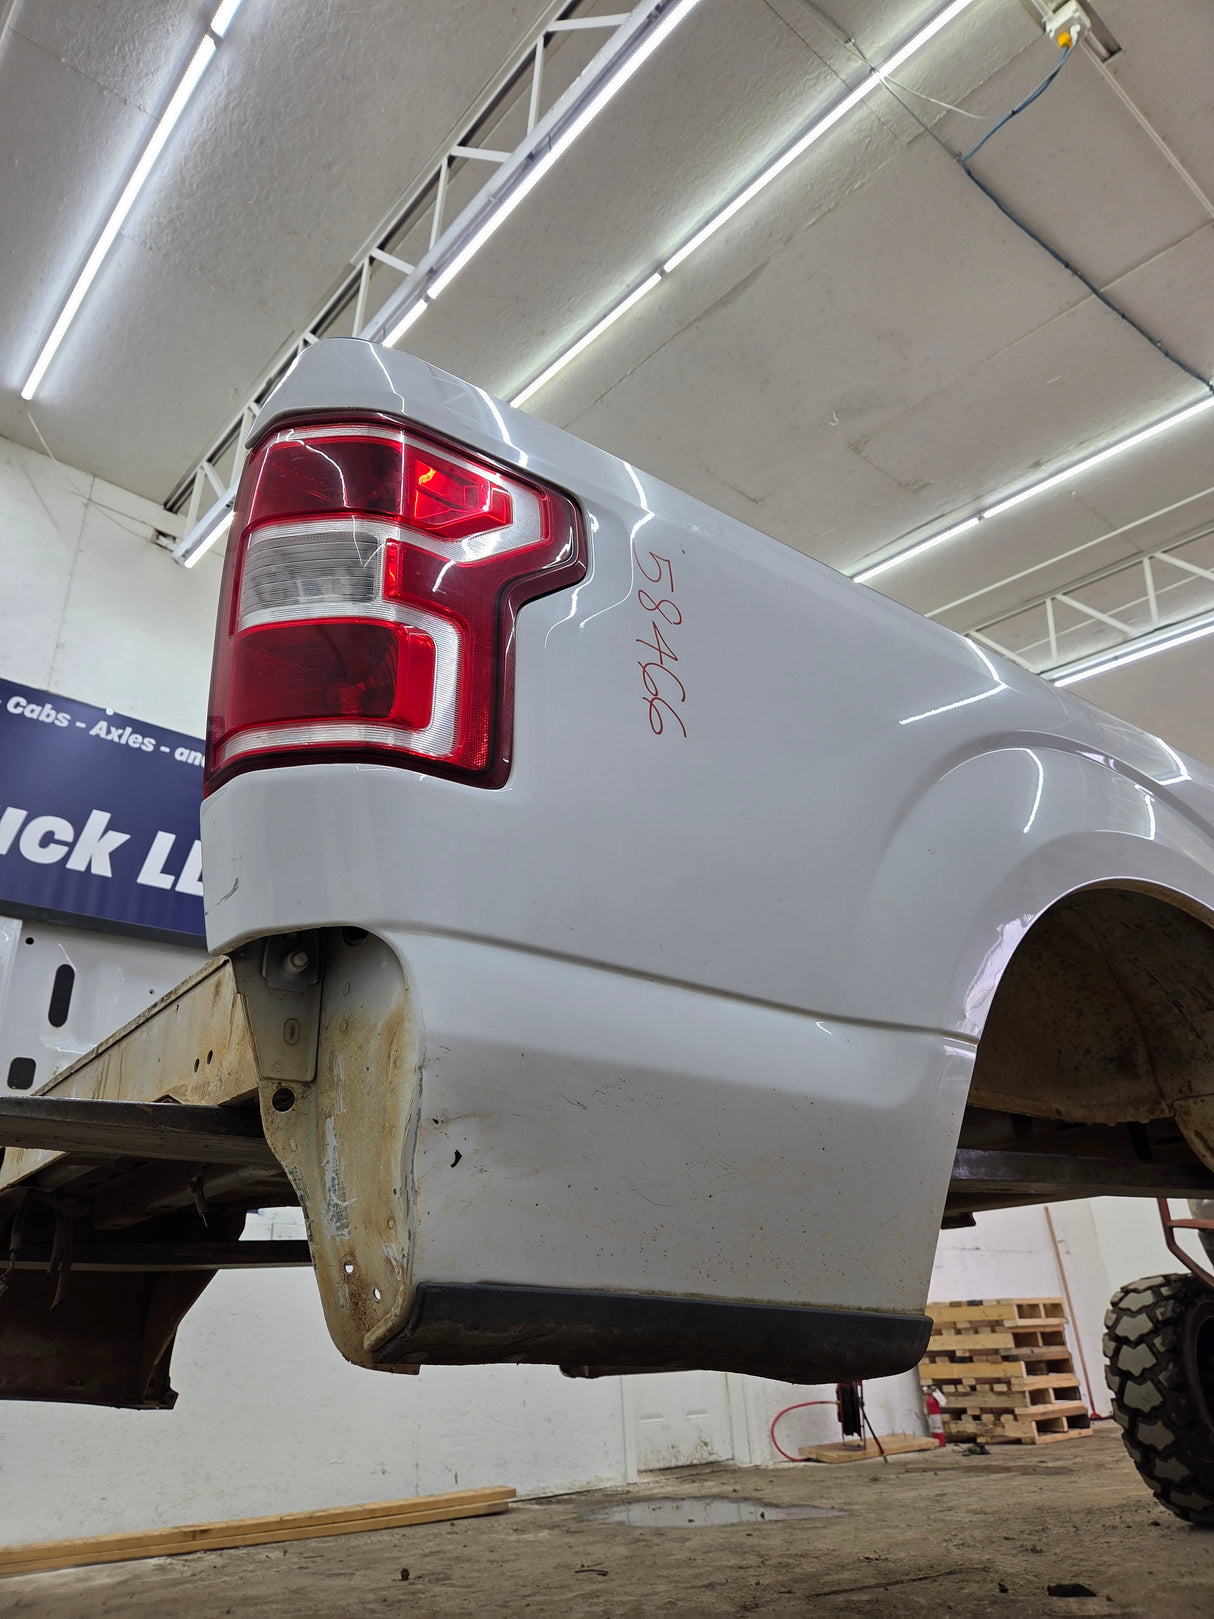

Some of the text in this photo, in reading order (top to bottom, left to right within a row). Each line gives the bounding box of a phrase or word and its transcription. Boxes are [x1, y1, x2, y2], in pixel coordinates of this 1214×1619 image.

[632, 538, 688, 738] 58466
[6, 696, 72, 728] Cabs
[88, 720, 156, 752] Axles
[174, 746, 205, 769] an
